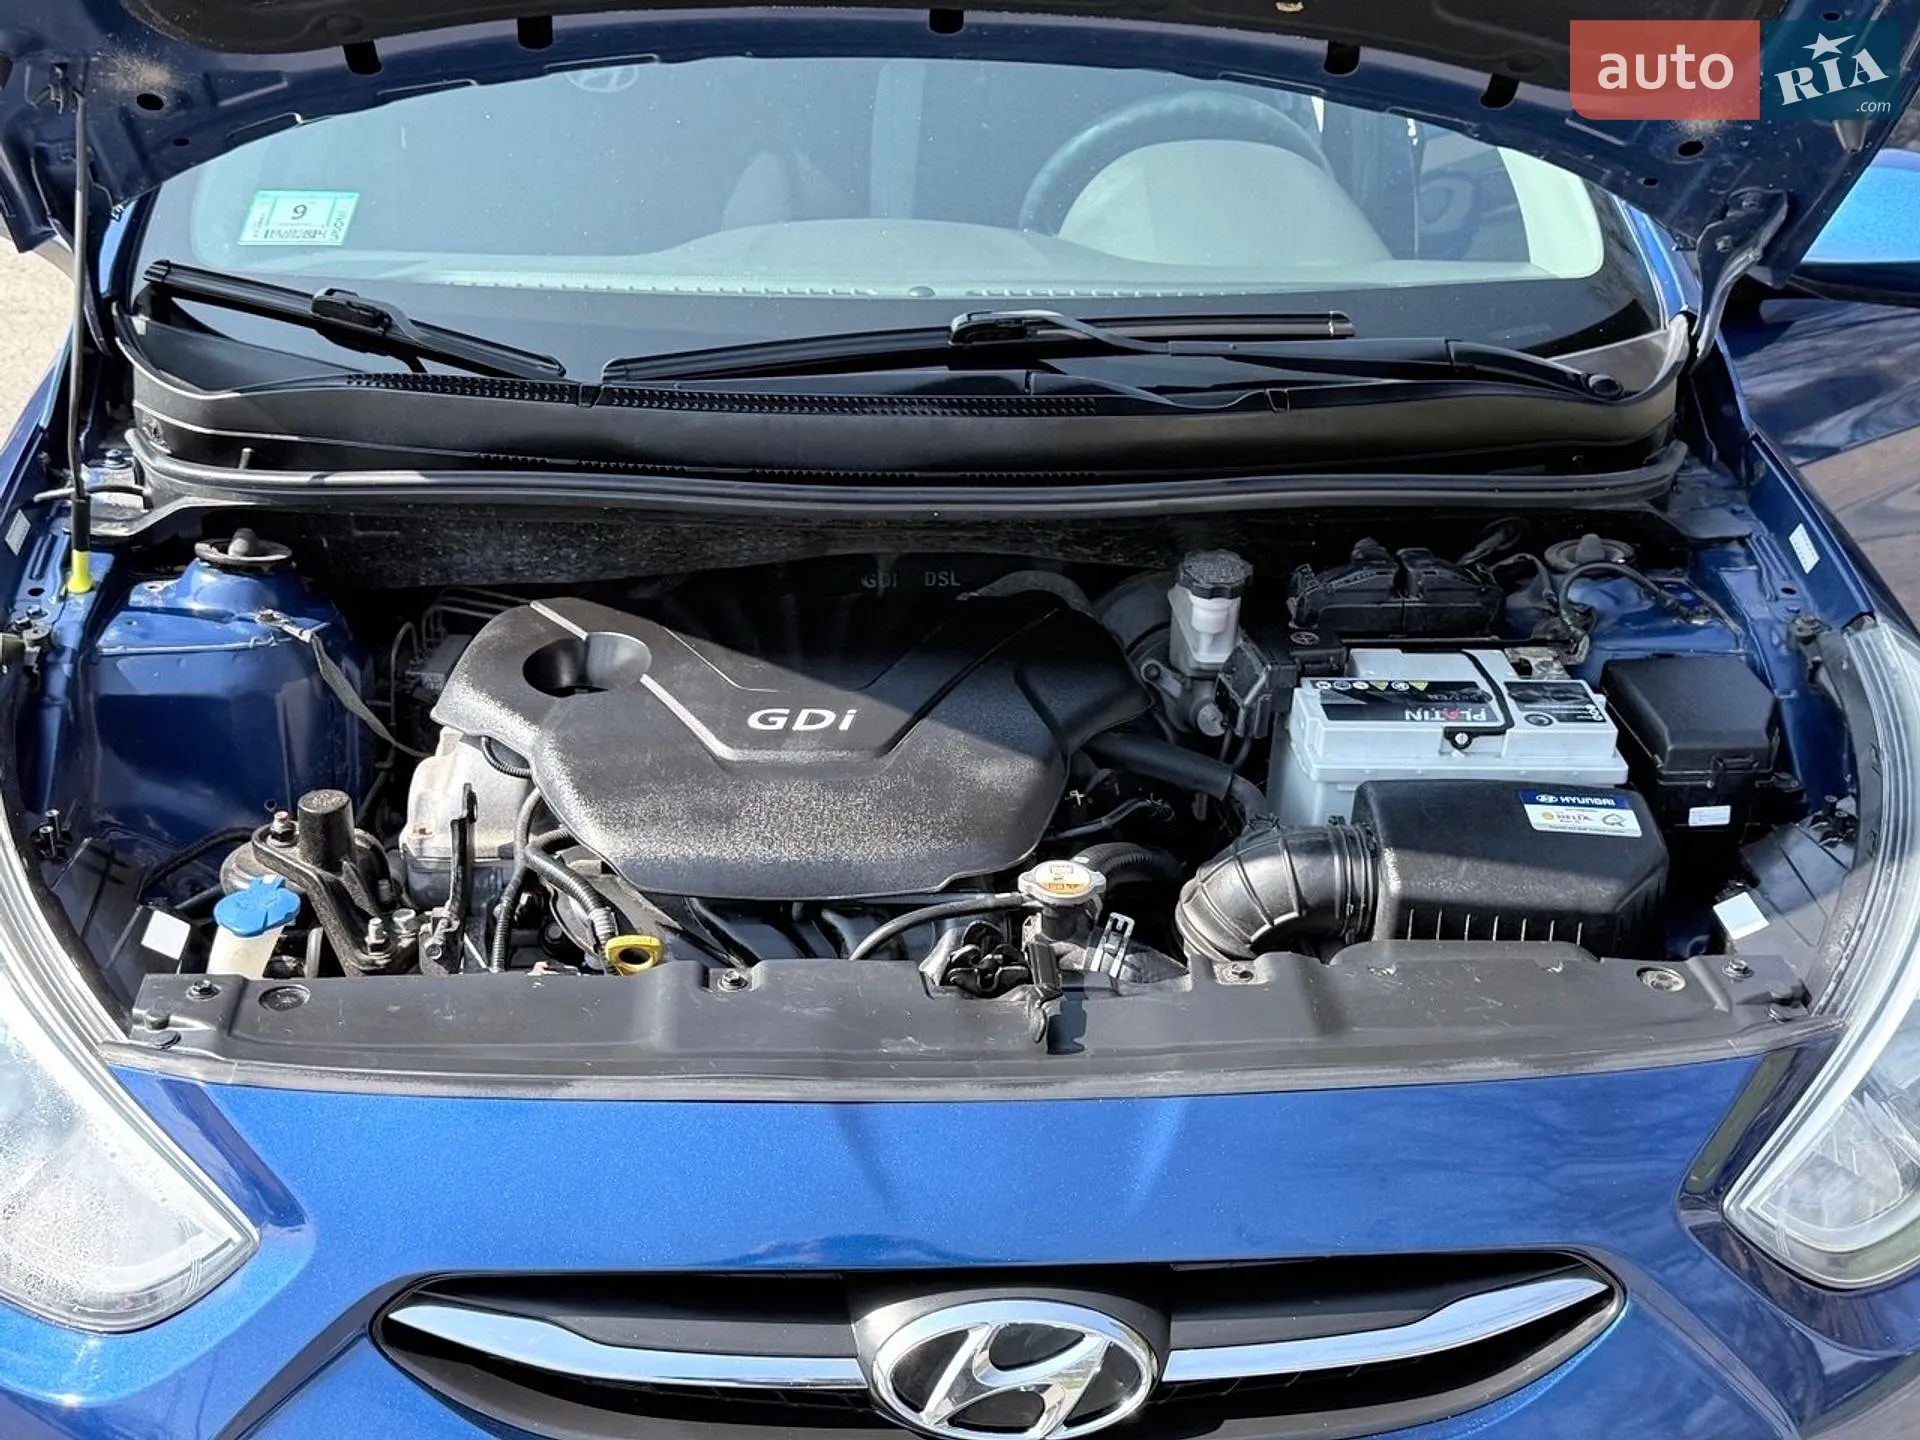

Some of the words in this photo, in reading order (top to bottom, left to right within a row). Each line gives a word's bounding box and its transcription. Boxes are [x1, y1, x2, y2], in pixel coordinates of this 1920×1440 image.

[290, 204, 308, 220] 9
[924, 570, 961, 587] DSL
[747, 708, 858, 731] GDi
[1559, 796, 1616, 806] HYUNDAI
